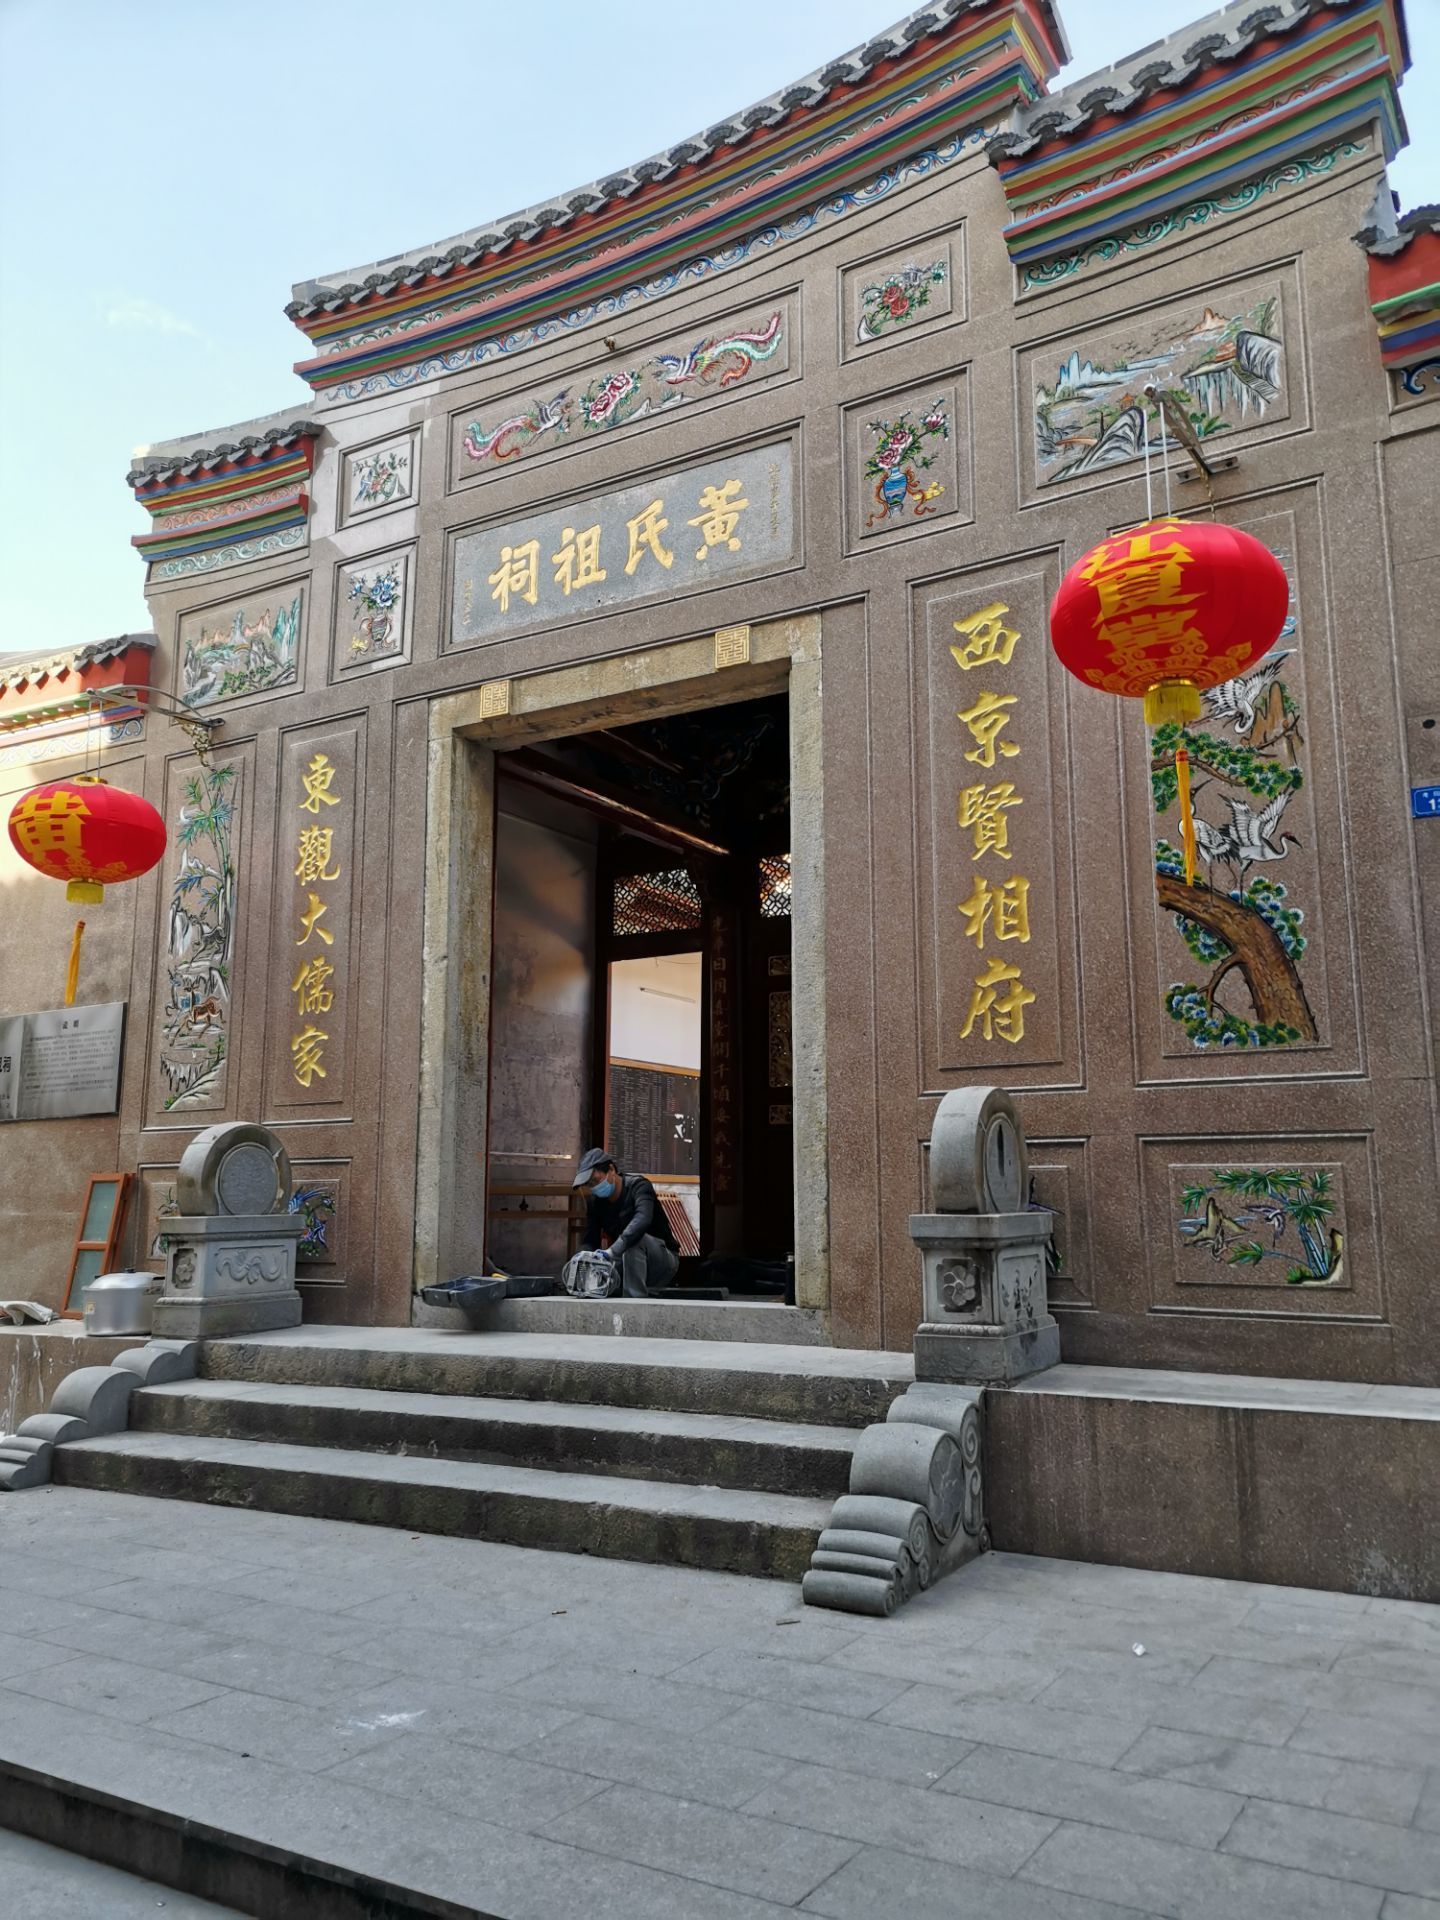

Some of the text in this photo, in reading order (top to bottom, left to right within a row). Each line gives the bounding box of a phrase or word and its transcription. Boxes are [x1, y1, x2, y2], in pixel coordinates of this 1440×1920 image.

[291, 753, 341, 1088] 東觀大儒家
[950, 602, 1036, 1044] 西京賢相府
